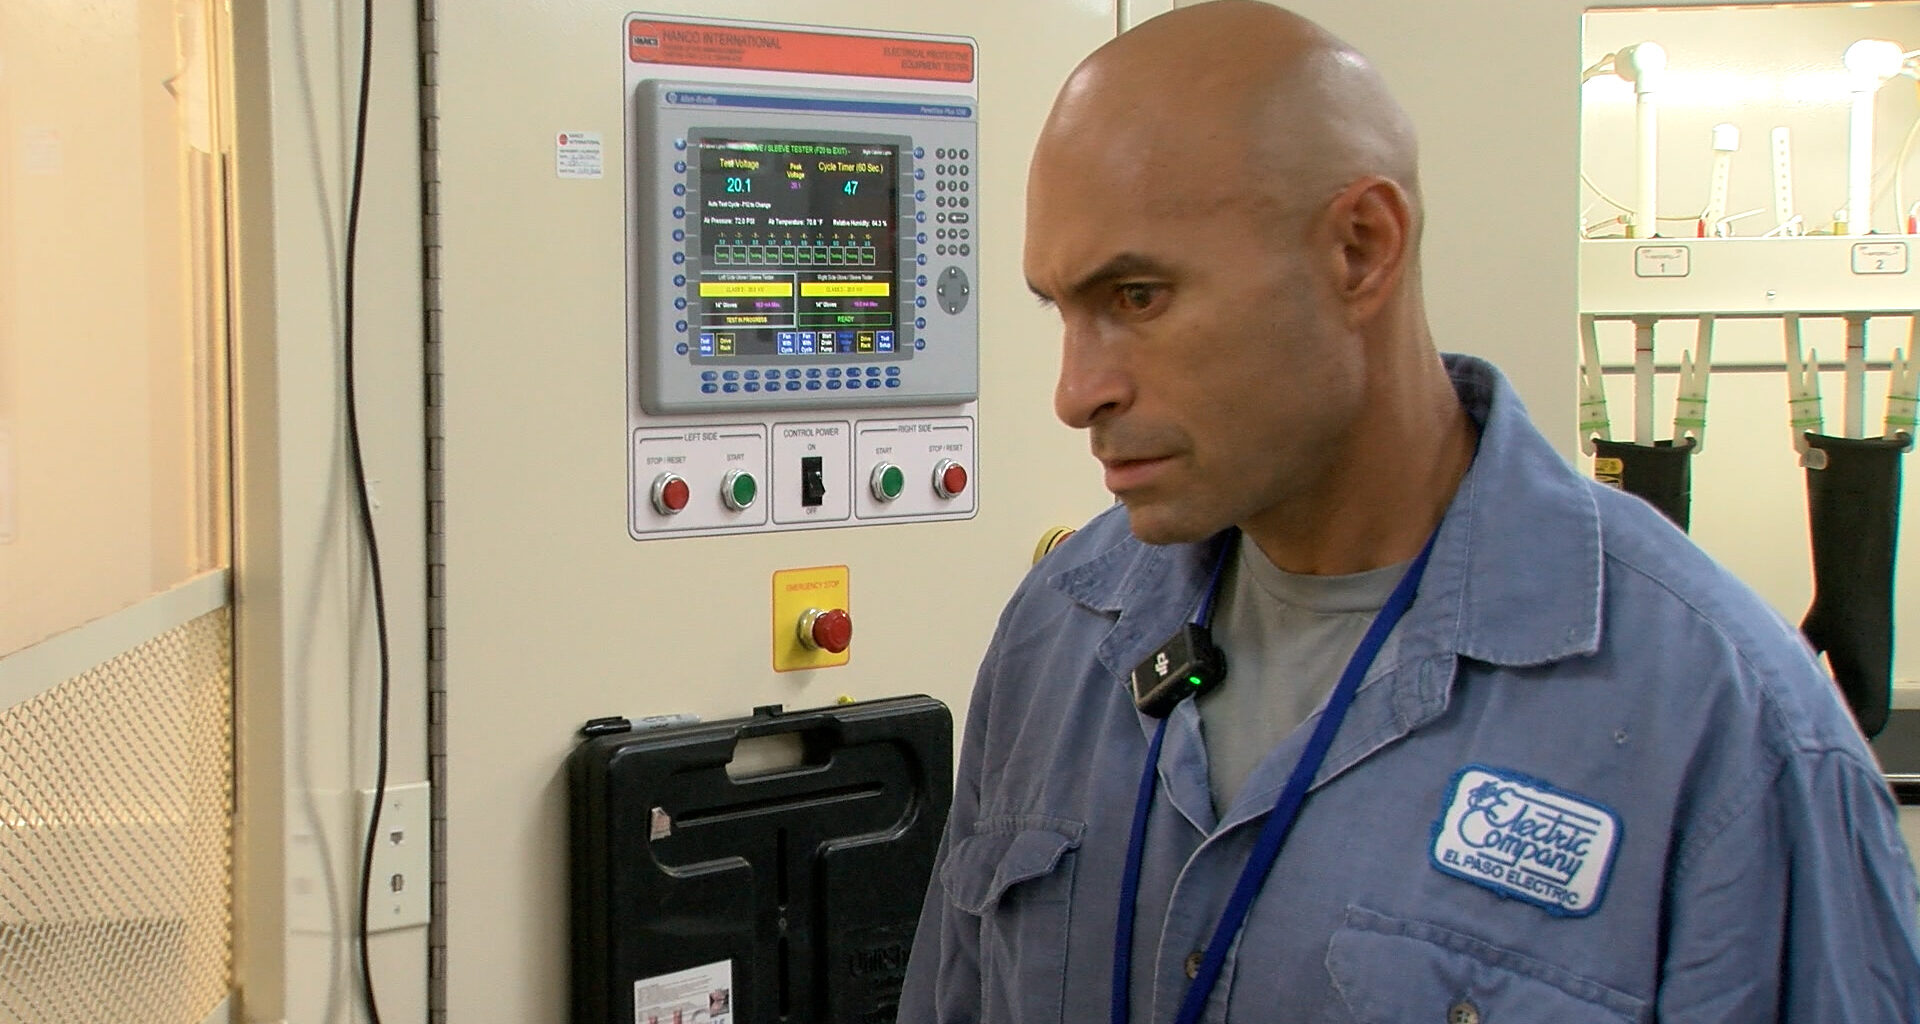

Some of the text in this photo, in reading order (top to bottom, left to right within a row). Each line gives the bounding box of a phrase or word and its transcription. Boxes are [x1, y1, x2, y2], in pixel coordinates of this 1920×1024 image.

[662, 30, 782, 49] HANCO INTERNATIONAL
[768, 144, 790, 154] SLEEVE
[791, 145, 814, 154] TESTER
[720, 158, 760, 171] Test Voltage
[818, 162, 837, 172] Cycle
[838, 162, 856, 172] Timer
[726, 177, 751, 192] 20.1
[844, 180, 858, 196] 47
[1876, 260, 1884, 270] 2
[783, 427, 838, 438] CONTROL POWER
[898, 423, 932, 434] RIGHT SIDE
[684, 432, 718, 442] LEFT SIDE
[808, 442, 816, 450] ON
[928, 444, 942, 452] STOP
[946, 444, 963, 452] RESET
[646, 457, 662, 465] STOP
[666, 456, 686, 464] RESET
[726, 454, 744, 462] START
[1484, 786, 1593, 856] Electric
[1457, 807, 1584, 886] Company
[1442, 848, 1580, 906] EL PASO ELECTRIC
